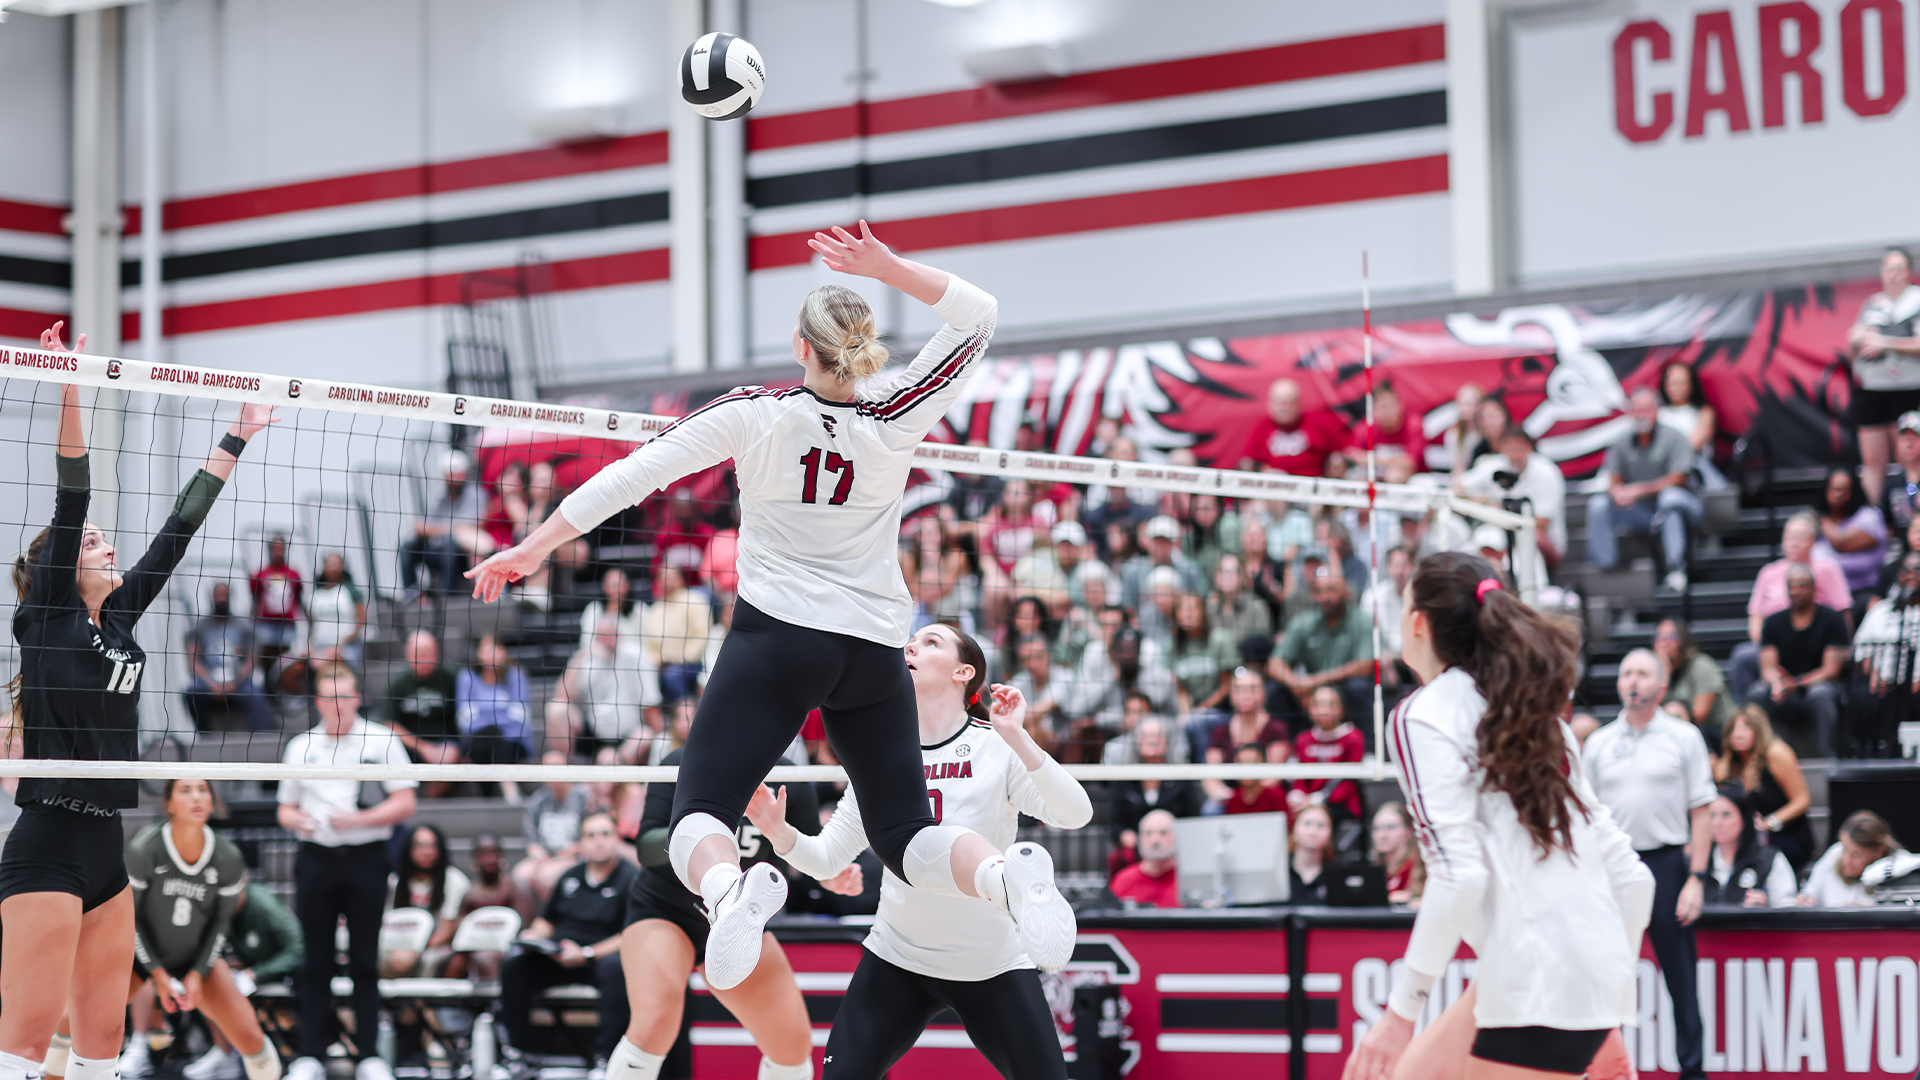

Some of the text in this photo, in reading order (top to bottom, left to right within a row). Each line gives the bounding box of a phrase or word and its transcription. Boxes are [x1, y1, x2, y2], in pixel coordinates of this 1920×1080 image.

[1612, 0, 1907, 143] CARO
[14, 351, 78, 371] GAMECOCKS
[150, 366, 261, 391] CAROLINA GAMECOCKS
[328, 386, 430, 408] CAROLINA GAMECOCKS
[490, 403, 585, 425] CAROLINA GAMECOCKS
[799, 446, 855, 505] 17
[82, 802, 115, 817] PRO
[171, 896, 193, 927] 8
[1834, 957, 1919, 1074] VO
